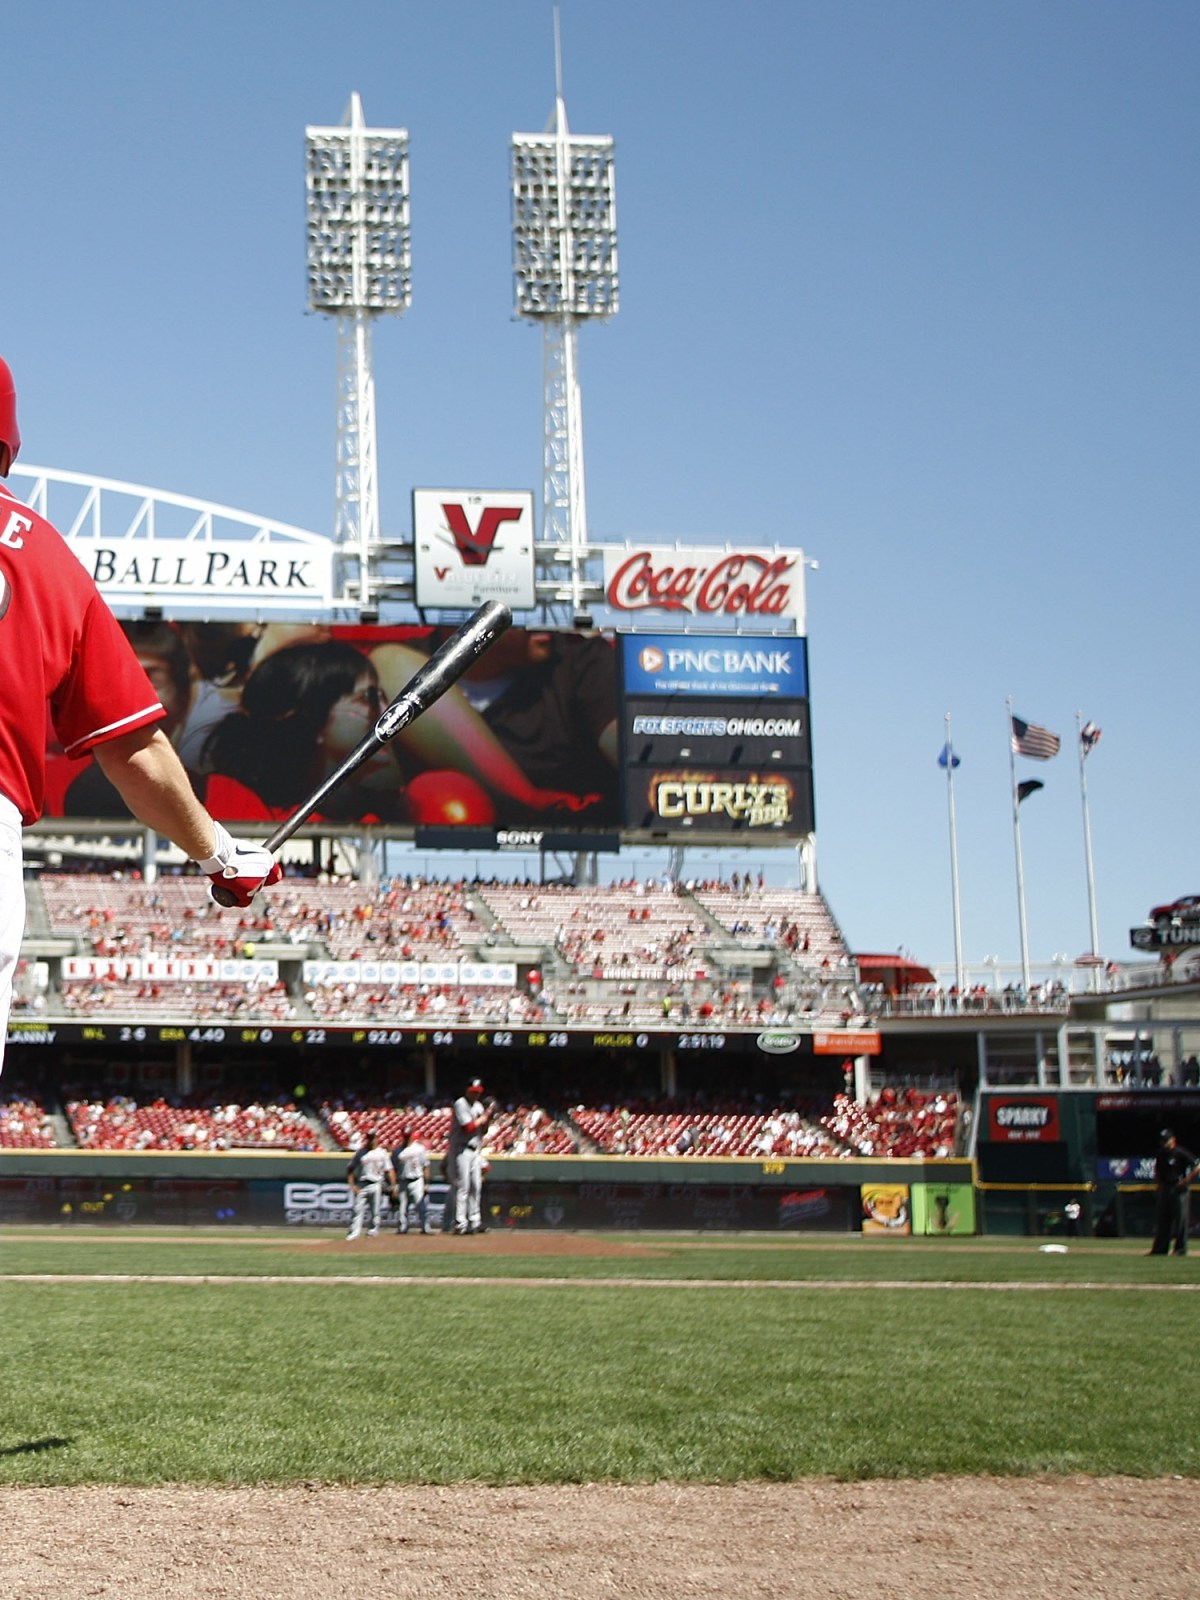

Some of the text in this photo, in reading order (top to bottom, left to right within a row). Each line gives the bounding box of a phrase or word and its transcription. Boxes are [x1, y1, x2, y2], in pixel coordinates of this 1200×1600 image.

[93, 548, 316, 589] BALL PARK
[607, 552, 797, 614] Coca-Cola
[668, 651, 792, 674] PNC BANK
[657, 783, 789, 819] CURLY'S
[496, 830, 544, 845] SONY
[1157, 928, 1200, 945] TUN
[159, 1029, 186, 1041] ERA
[188, 1027, 225, 1042] 4.40
[306, 1029, 327, 1043] 22
[367, 1030, 402, 1045] 92.0
[432, 1031, 454, 1045] 94
[996, 1106, 1049, 1127] SPARKY
